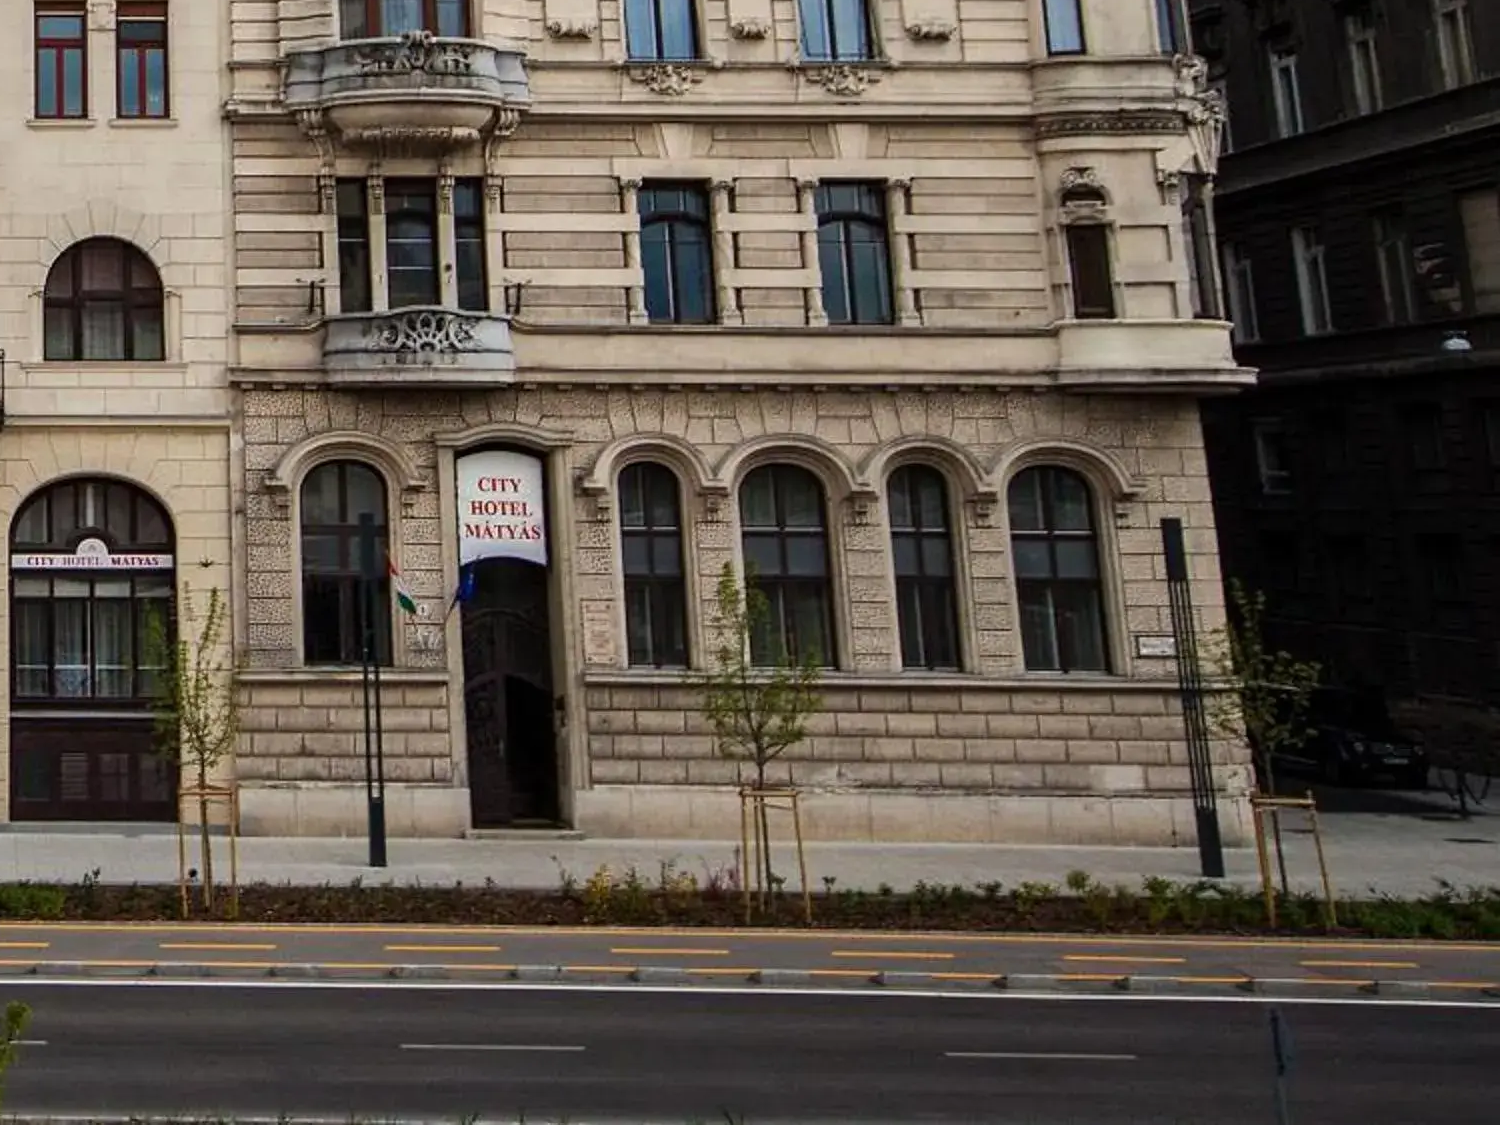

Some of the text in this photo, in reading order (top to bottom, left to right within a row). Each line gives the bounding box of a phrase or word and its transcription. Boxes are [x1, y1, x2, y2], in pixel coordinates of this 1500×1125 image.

[477, 477, 522, 493] CITY
[470, 500, 533, 517] HOTEL
[464, 520, 542, 541] MÁTYÁS
[27, 556, 55, 566] CITY
[62, 556, 103, 566] HOTEL
